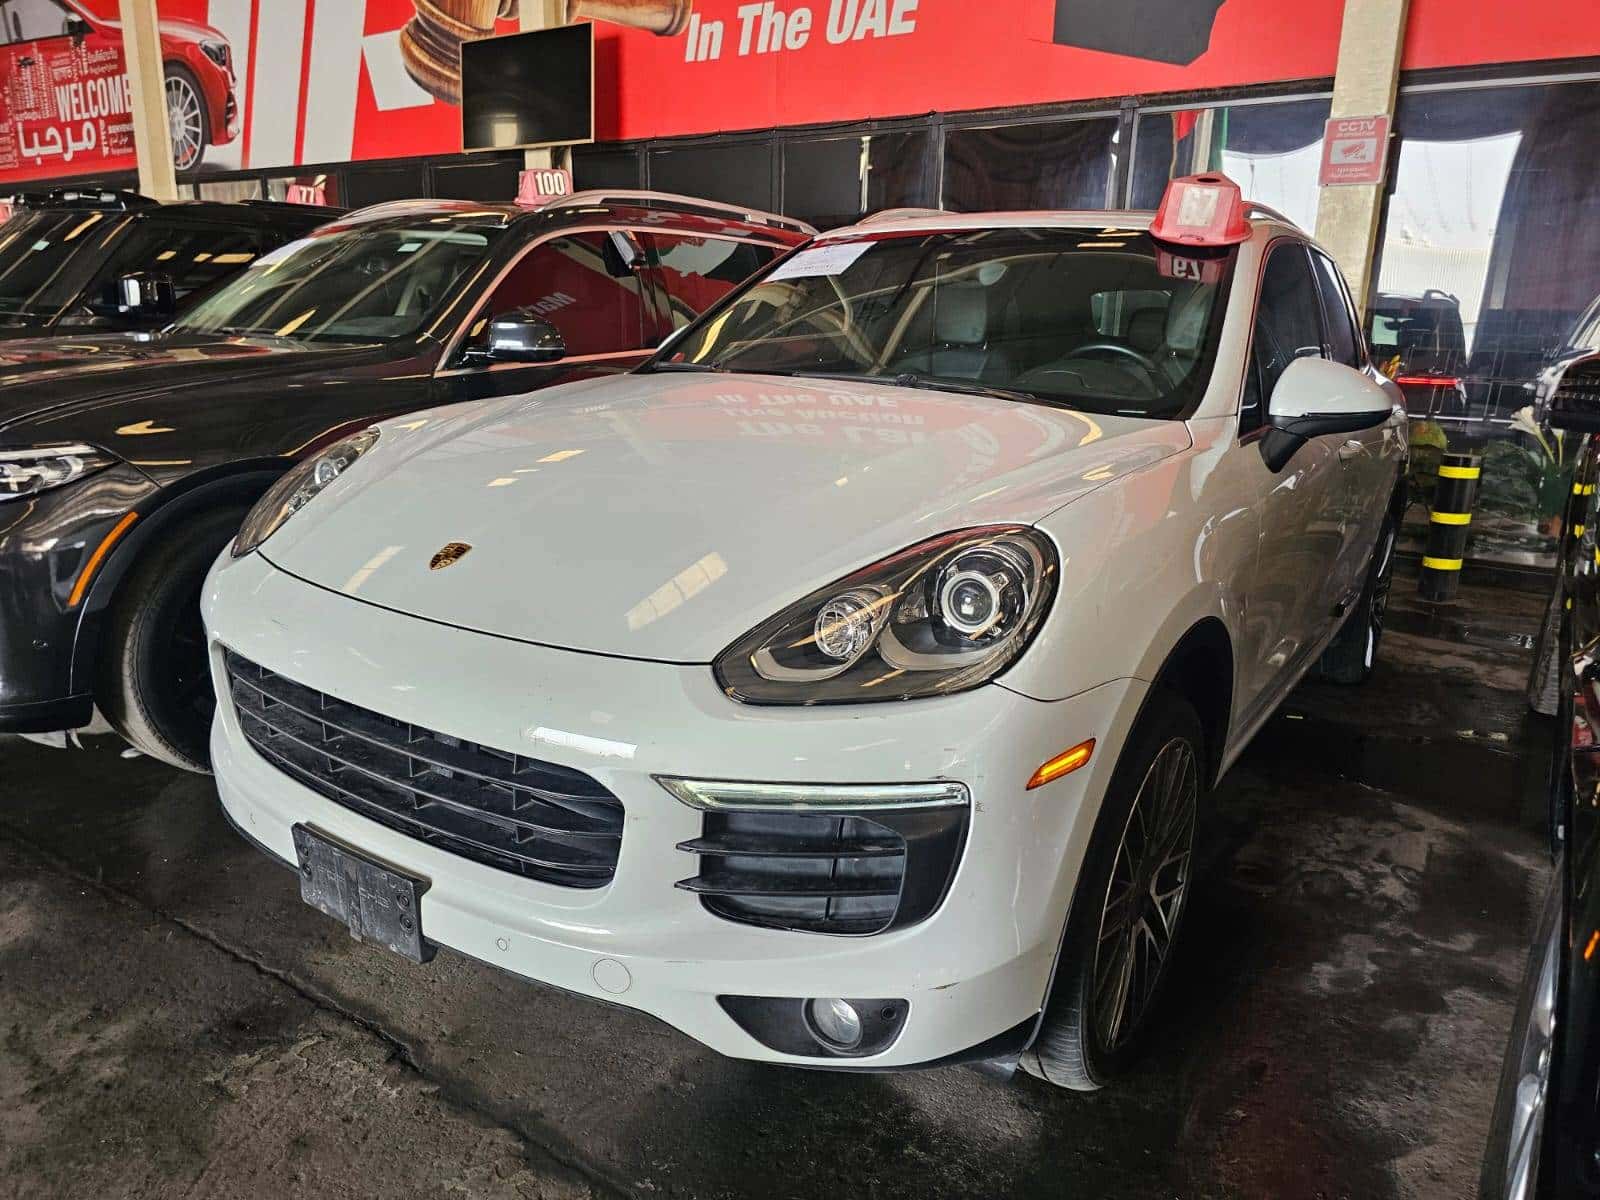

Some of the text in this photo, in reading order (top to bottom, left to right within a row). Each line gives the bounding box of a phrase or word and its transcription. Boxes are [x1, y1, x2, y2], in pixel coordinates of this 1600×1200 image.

[685, 0, 918, 63] In The UAE
[18, 120, 97, 165] مرحبا
[1338, 119, 1377, 132] CCTV
[536, 172, 565, 196] 100
